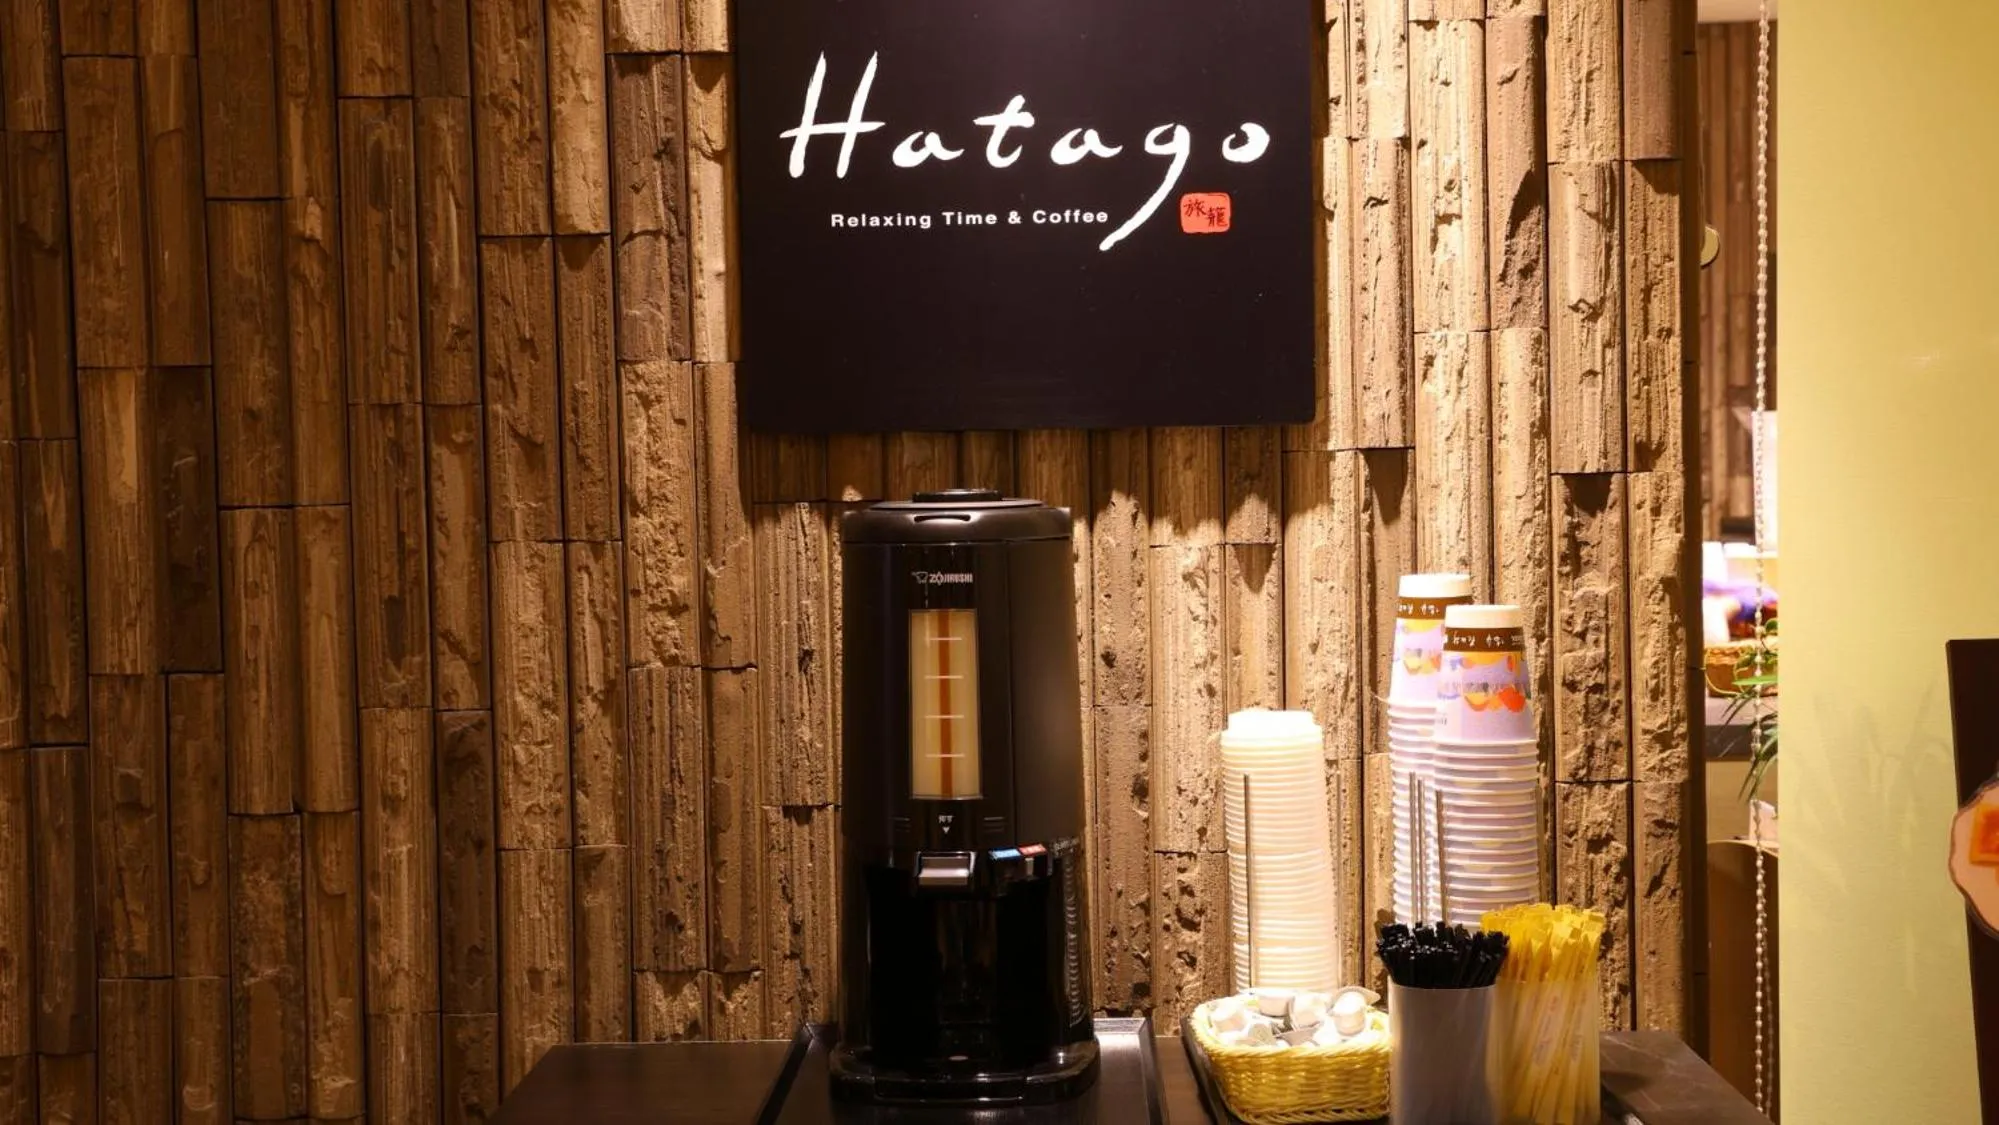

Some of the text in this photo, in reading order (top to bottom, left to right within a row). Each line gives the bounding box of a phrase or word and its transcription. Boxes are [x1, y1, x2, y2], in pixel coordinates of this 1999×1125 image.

[780, 50, 1270, 251] Hatago
[831, 209, 1109, 230] Relaxing Time & Coffee
[929, 571, 973, 586] ZOJIRUSHI
